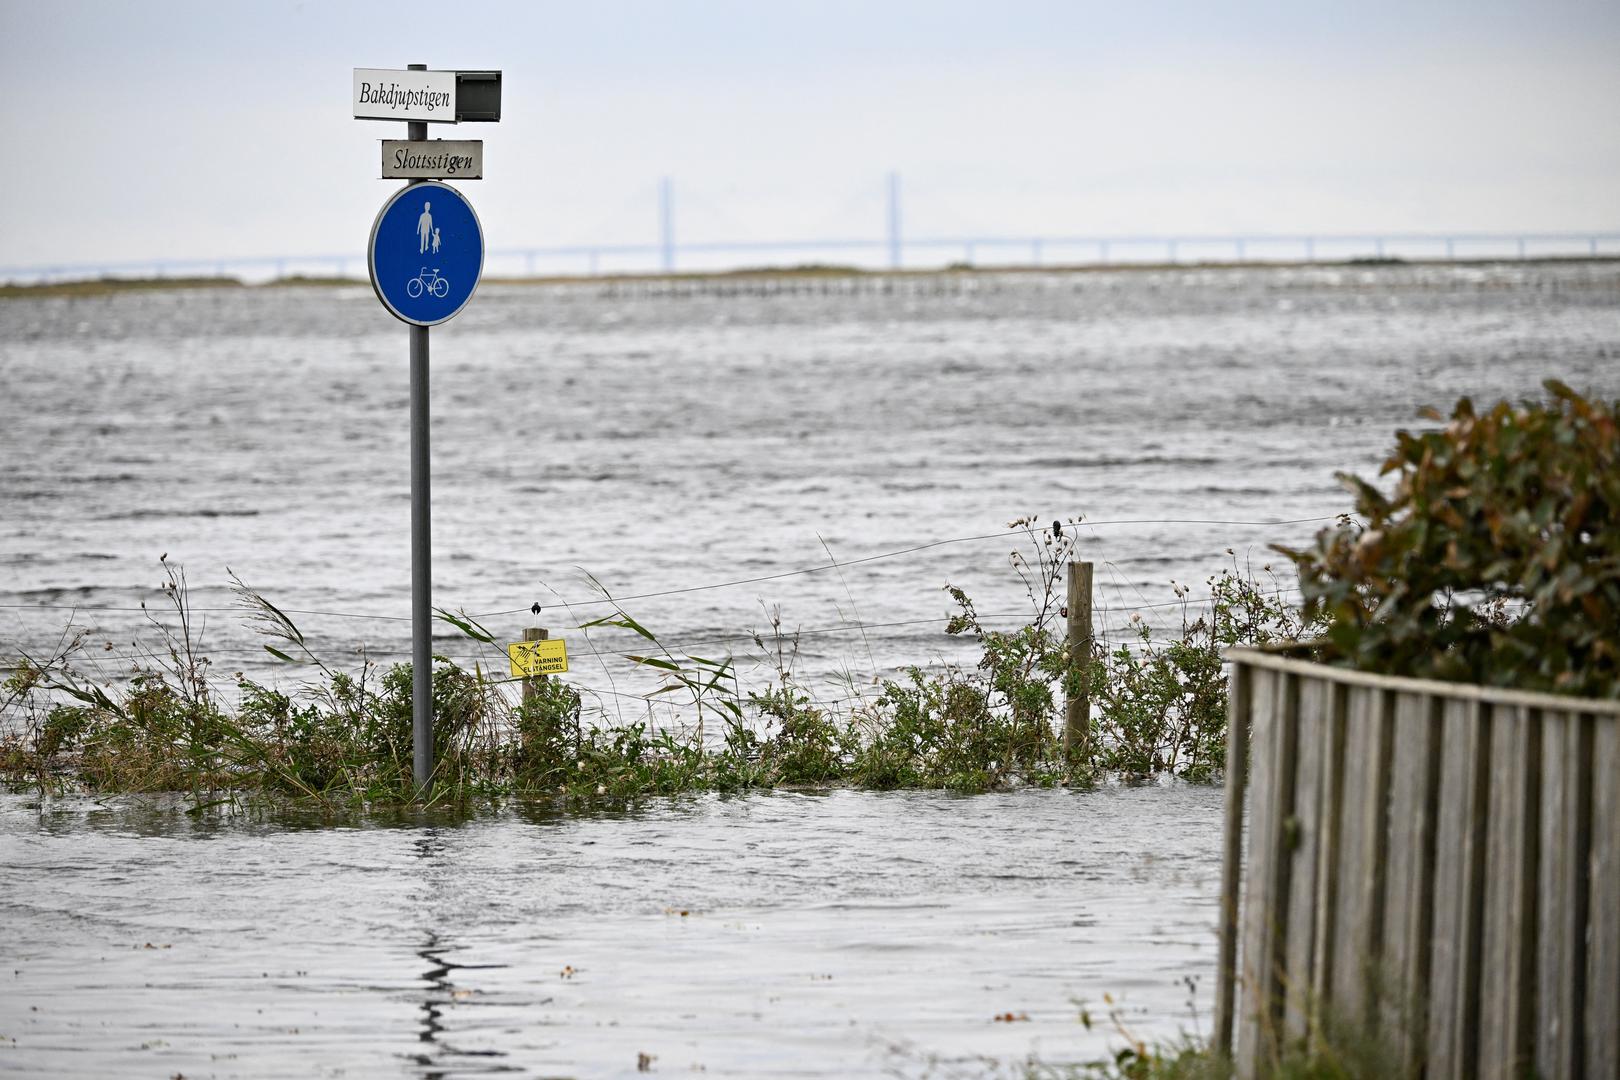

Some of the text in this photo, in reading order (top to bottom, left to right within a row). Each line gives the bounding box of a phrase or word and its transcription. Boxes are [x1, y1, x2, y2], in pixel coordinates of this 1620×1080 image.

[359, 82, 450, 111] Bakdjupstigen
[393, 148, 473, 174] Slottsstigen
[534, 656, 563, 665] VARNING
